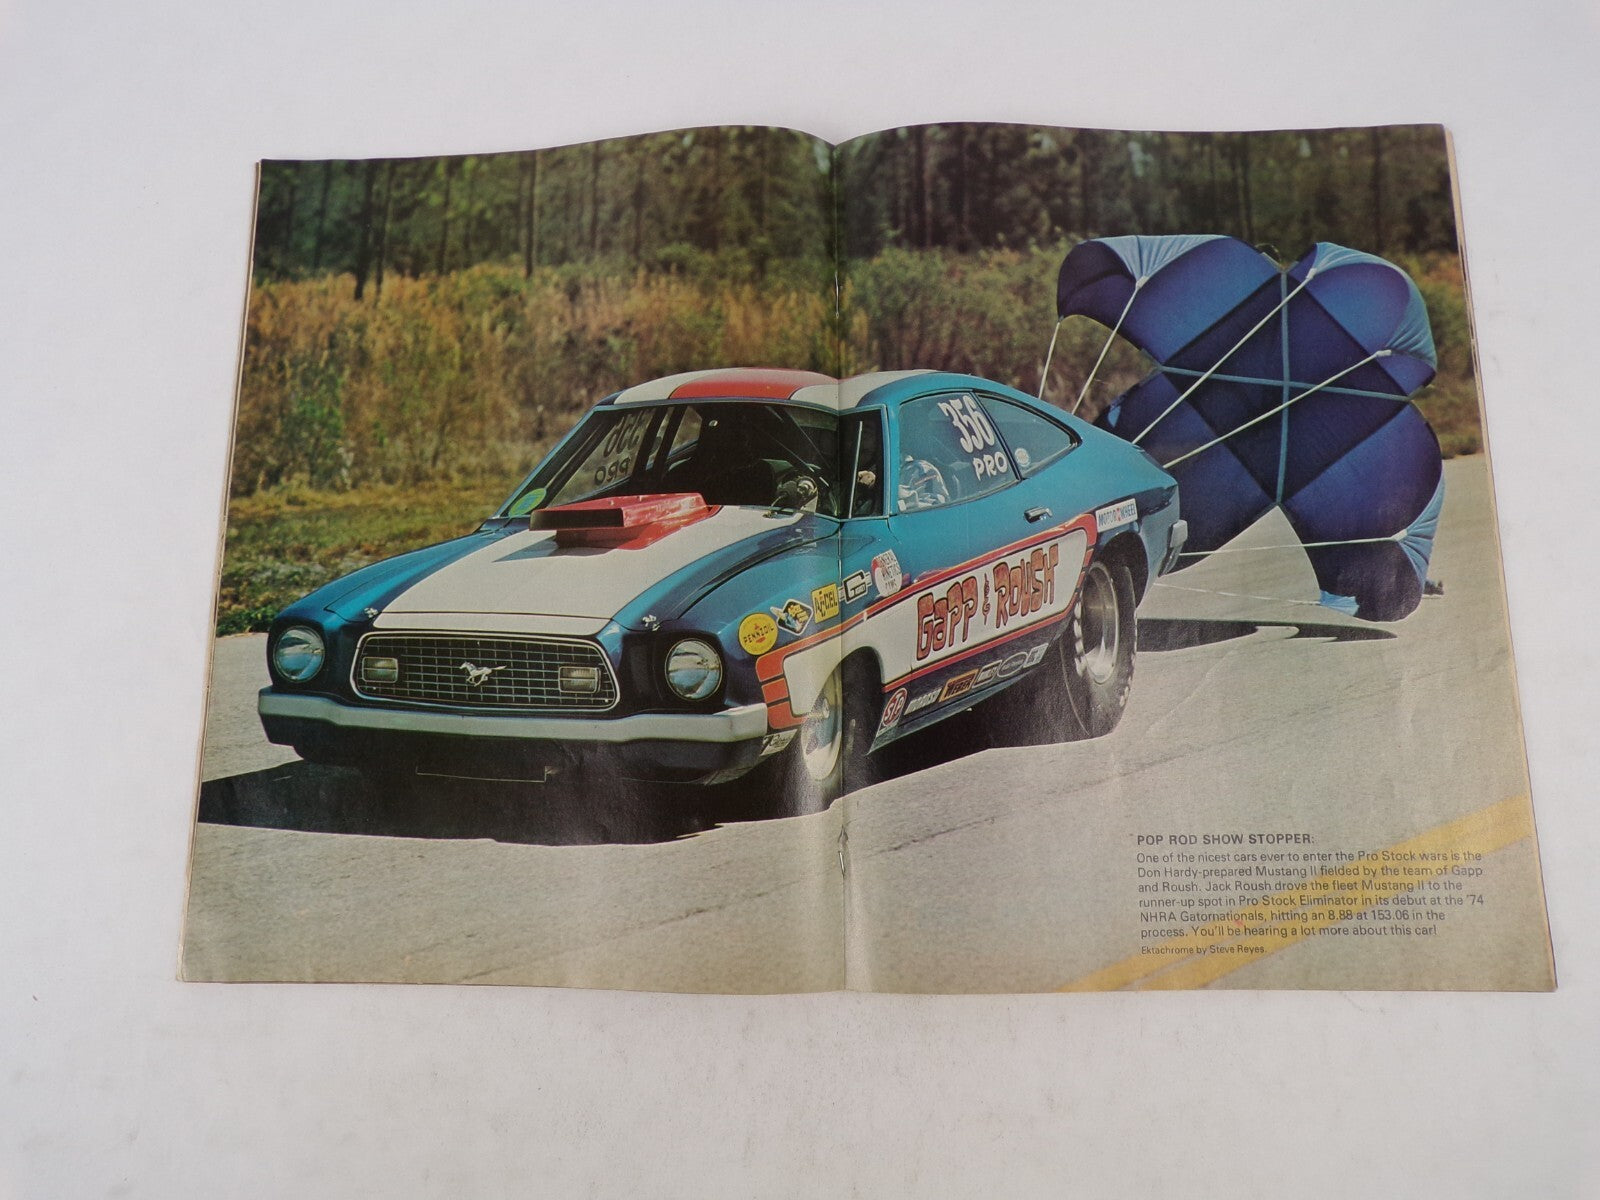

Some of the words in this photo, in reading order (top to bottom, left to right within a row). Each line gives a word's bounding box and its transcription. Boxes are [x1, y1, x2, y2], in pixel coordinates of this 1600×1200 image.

[938, 396, 995, 453] 356
[972, 452, 1008, 481] PRO
[743, 625, 775, 644] PENNZOIL
[1137, 835, 1163, 845] POP
[1169, 835, 1198, 845] ROD
[1202, 834, 1243, 844] SHOW
[1249, 834, 1314, 844] STOPPER:
[1137, 853, 1159, 863] One
[1163, 852, 1174, 862] of
[1177, 852, 1194, 862] the
[1198, 853, 1231, 862] nicest
[1234, 853, 1257, 862] cars
[1261, 854, 1284, 862] ever
[1288, 853, 1299, 861] to
[1303, 852, 1332, 861] enter
[1336, 852, 1354, 861] the
[1358, 851, 1378, 861] Pro
[1382, 851, 1416, 861] Stock
[1419, 852, 1448, 861] wars
[1452, 851, 1460, 860] is
[1463, 851, 1481, 860] the
[1138, 868, 1160, 878] Don
[1165, 866, 1251, 878] Hardy-prepared
[1256, 866, 1307, 878] Mustang
[1310, 866, 1316, 876] II
[1321, 866, 1359, 876] fielded
[1363, 866, 1377, 877] by
[1382, 866, 1399, 875] the
[1403, 867, 1433, 875] team
[1437, 865, 1448, 875] of
[1452, 866, 1482, 877] Gapp
[1138, 882, 1158, 892] and
[1163, 882, 1201, 892] Roush.
[1205, 881, 1231, 891] Jack
[1235, 881, 1271, 891] Roush
[1275, 881, 1307, 890] drove
[1311, 881, 1329, 890] the
[1332, 880, 1357, 890] fleet
[1362, 880, 1413, 892] Mustang
[1418, 880, 1424, 890] II
[1428, 881, 1440, 890] to
[1444, 880, 1462, 890] the
[1139, 899, 1195, 908] runner-up
[1198, 897, 1222, 908] spot
[1226, 896, 1236, 906] in
[1239, 896, 1258, 906] Pro
[1262, 896, 1295, 905] Stock
[1301, 895, 1358, 905] Eliminator
[1362, 896, 1372, 905] in
[1376, 896, 1389, 905] its
[1392, 895, 1426, 905] debut
[1430, 896, 1441, 905] at
[1445, 895, 1463, 905] the
[1467, 895, 1483, 905] '74
[1141, 912, 1177, 922] NHRA
[1180, 911, 1267, 922] Gatornationals,
[1271, 911, 1308, 922] hitting
[1312, 912, 1325, 920] an
[1328, 910, 1352, 920] 8.88
[1357, 911, 1368, 920] at
[1372, 910, 1409, 920] 153.06
[1412, 911, 1422, 920] in
[1427, 910, 1445, 920] the
[1141, 928, 1188, 939] process.
[1192, 926, 1224, 936] You'll
[1228, 926, 1241, 936] be
[1244, 926, 1288, 938] hearing
[1301, 925, 1316, 935] lot
[1319, 927, 1349, 935] more
[1353, 925, 1387, 935] about
[1391, 925, 1411, 935] this
[1415, 925, 1437, 935] car!
[1141, 946, 1194, 955] Ektachrome
[1196, 945, 1207, 956] by
[1210, 945, 1235, 954] Steve
[1237, 944, 1267, 954] Reyes.
